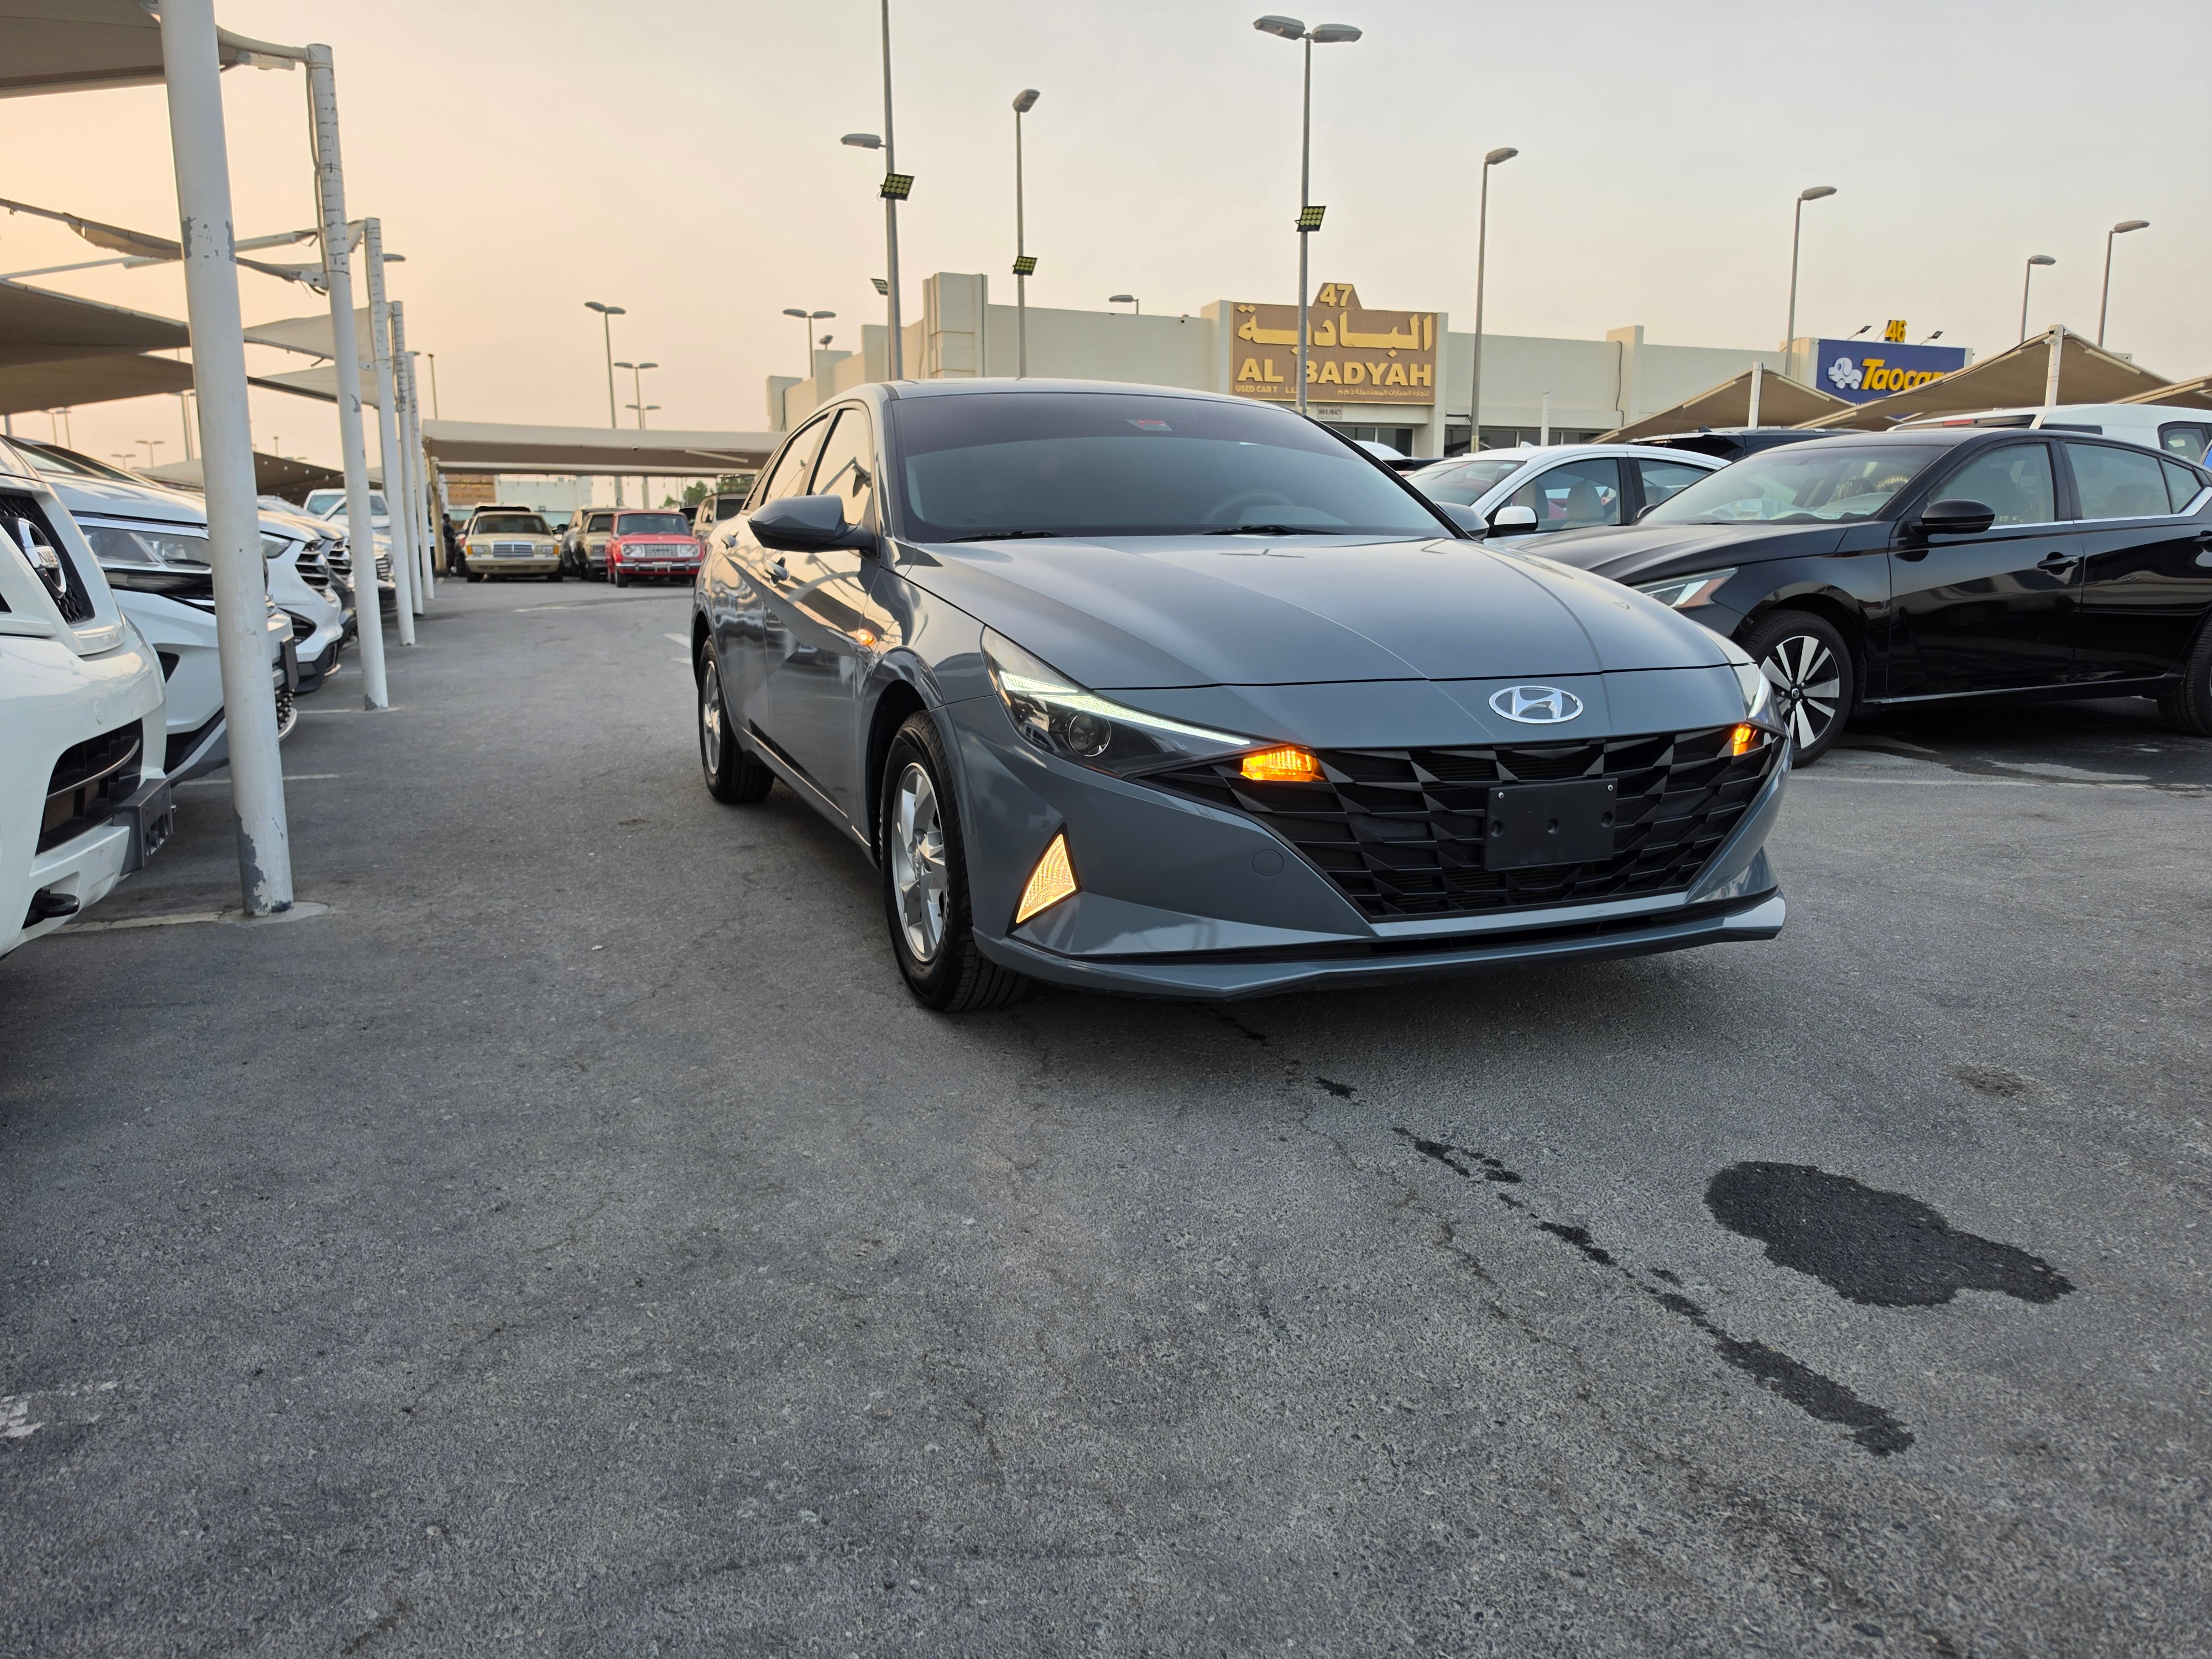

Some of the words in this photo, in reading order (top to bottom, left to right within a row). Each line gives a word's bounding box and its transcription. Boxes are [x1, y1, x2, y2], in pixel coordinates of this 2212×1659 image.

[1319, 283, 1353, 307] 47
[1237, 304, 1432, 358] البادية
[1885, 319, 1907, 343] 46
[1237, 358, 1284, 382] AL
[1860, 358, 1953, 392] Taoca
